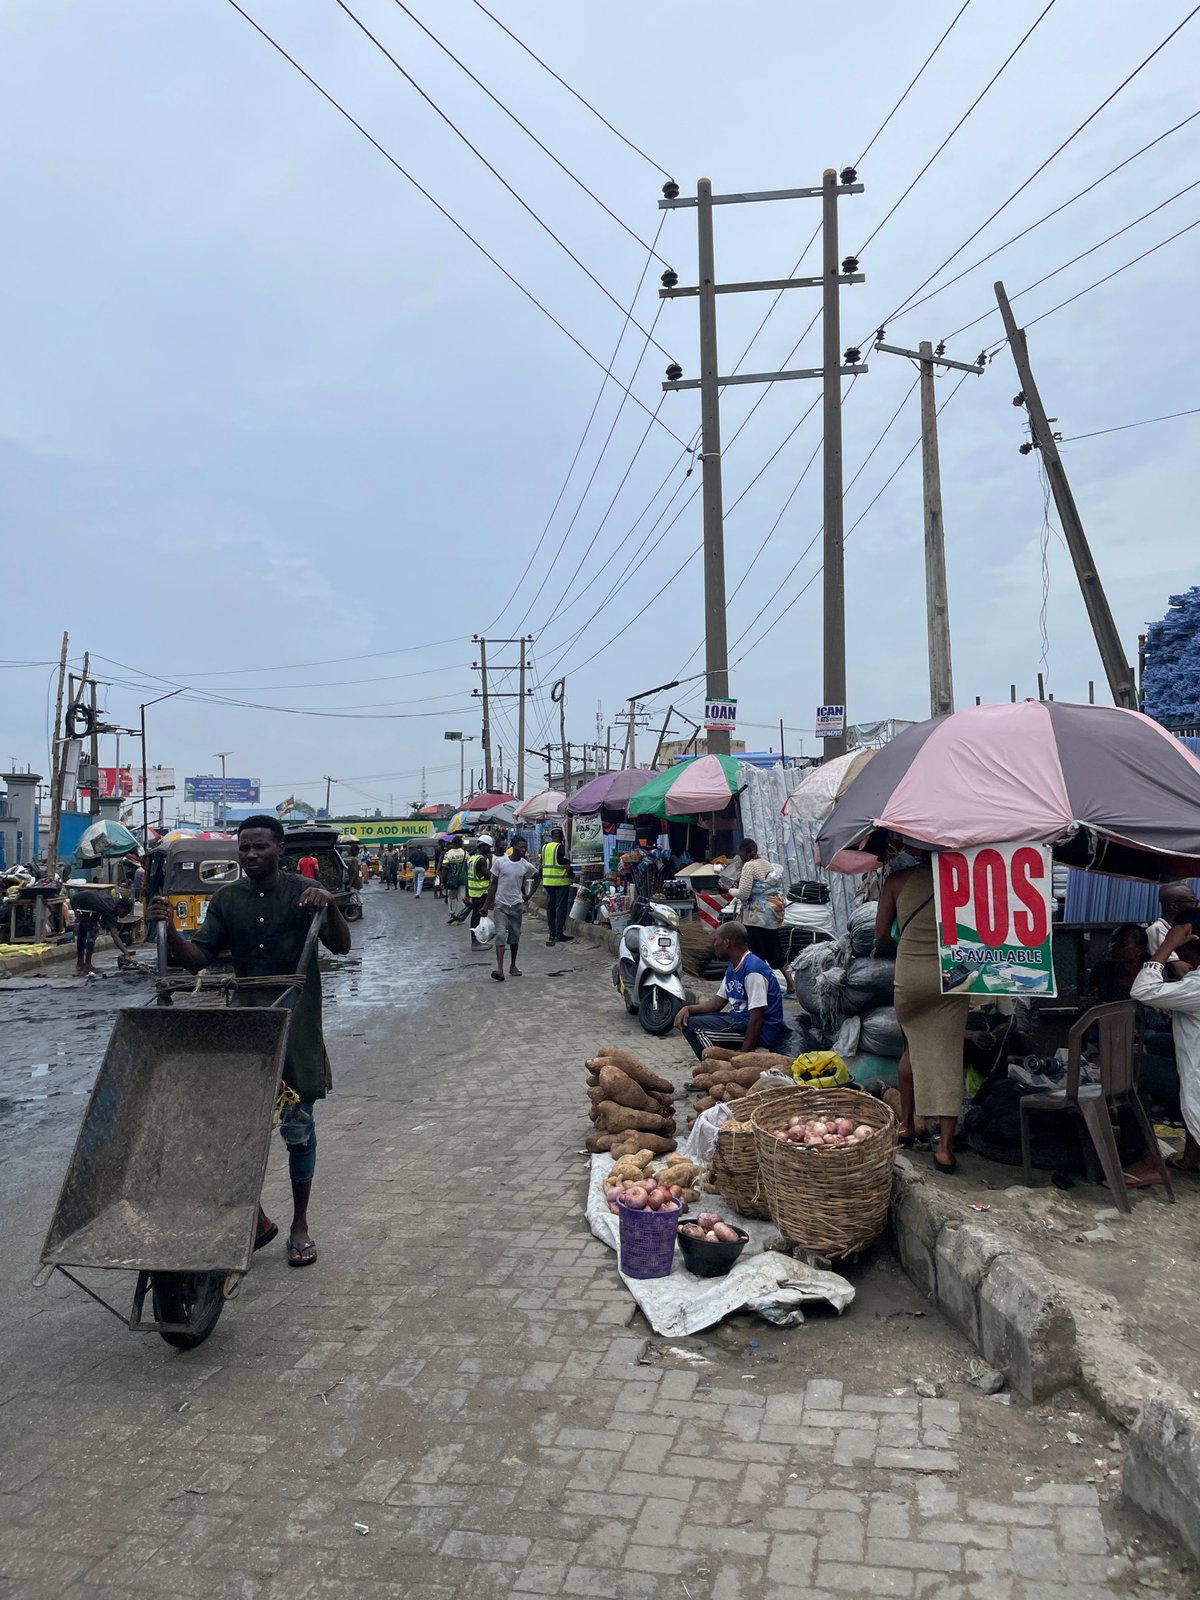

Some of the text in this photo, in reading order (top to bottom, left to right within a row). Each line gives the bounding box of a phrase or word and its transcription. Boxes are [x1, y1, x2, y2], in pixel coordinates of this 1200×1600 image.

[705, 705, 736, 719] LOAN
[817, 706, 843, 716] ICAN
[360, 826, 374, 835] TO
[376, 825, 398, 835] ADD
[401, 825, 428, 834] MILK!
[938, 847, 1048, 948] POS
[952, 950, 1042, 963] IS AVAILABLE
